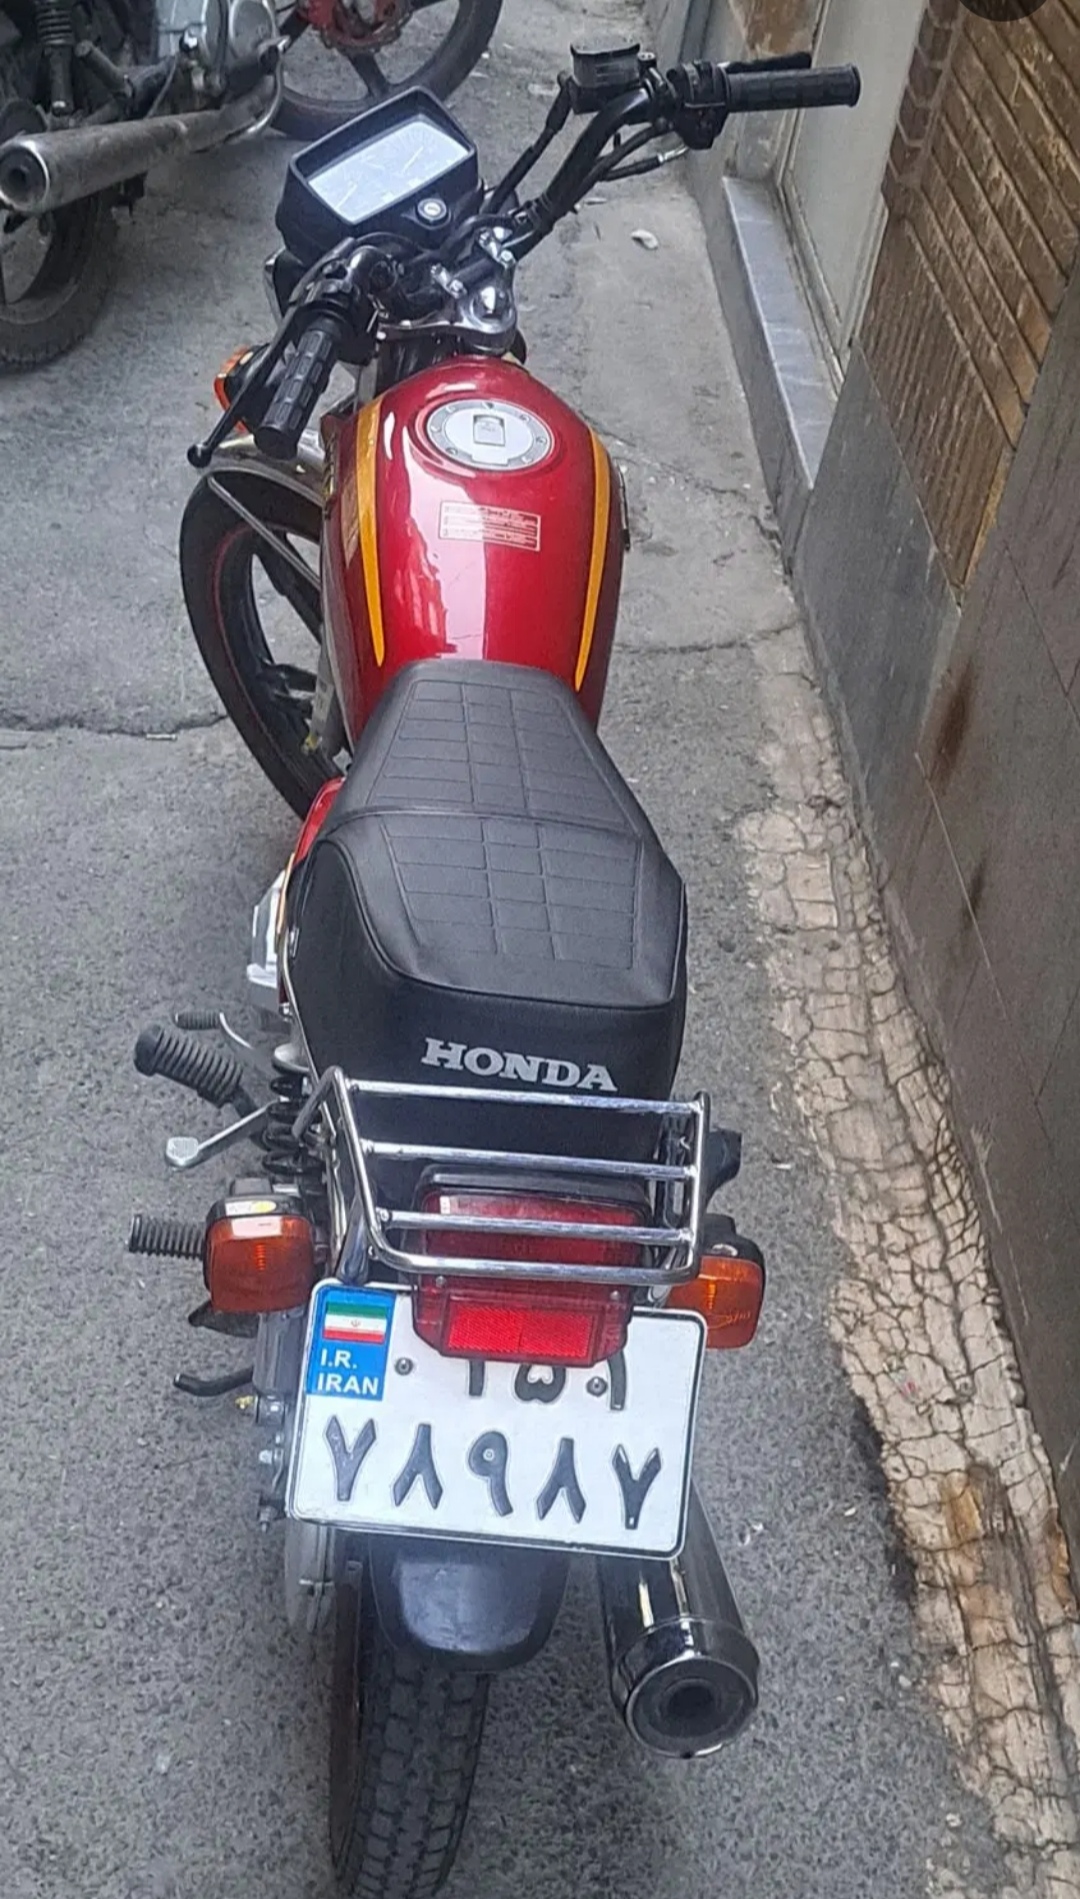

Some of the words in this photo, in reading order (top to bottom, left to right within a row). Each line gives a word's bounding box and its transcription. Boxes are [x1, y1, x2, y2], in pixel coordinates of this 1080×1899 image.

[421, 1037, 618, 1092] HONDA
[320, 1348, 357, 1370] I.R.
[317, 1371, 379, 1396] IRAN
[325, 1414, 663, 1530] ۷۸۹۸۷
